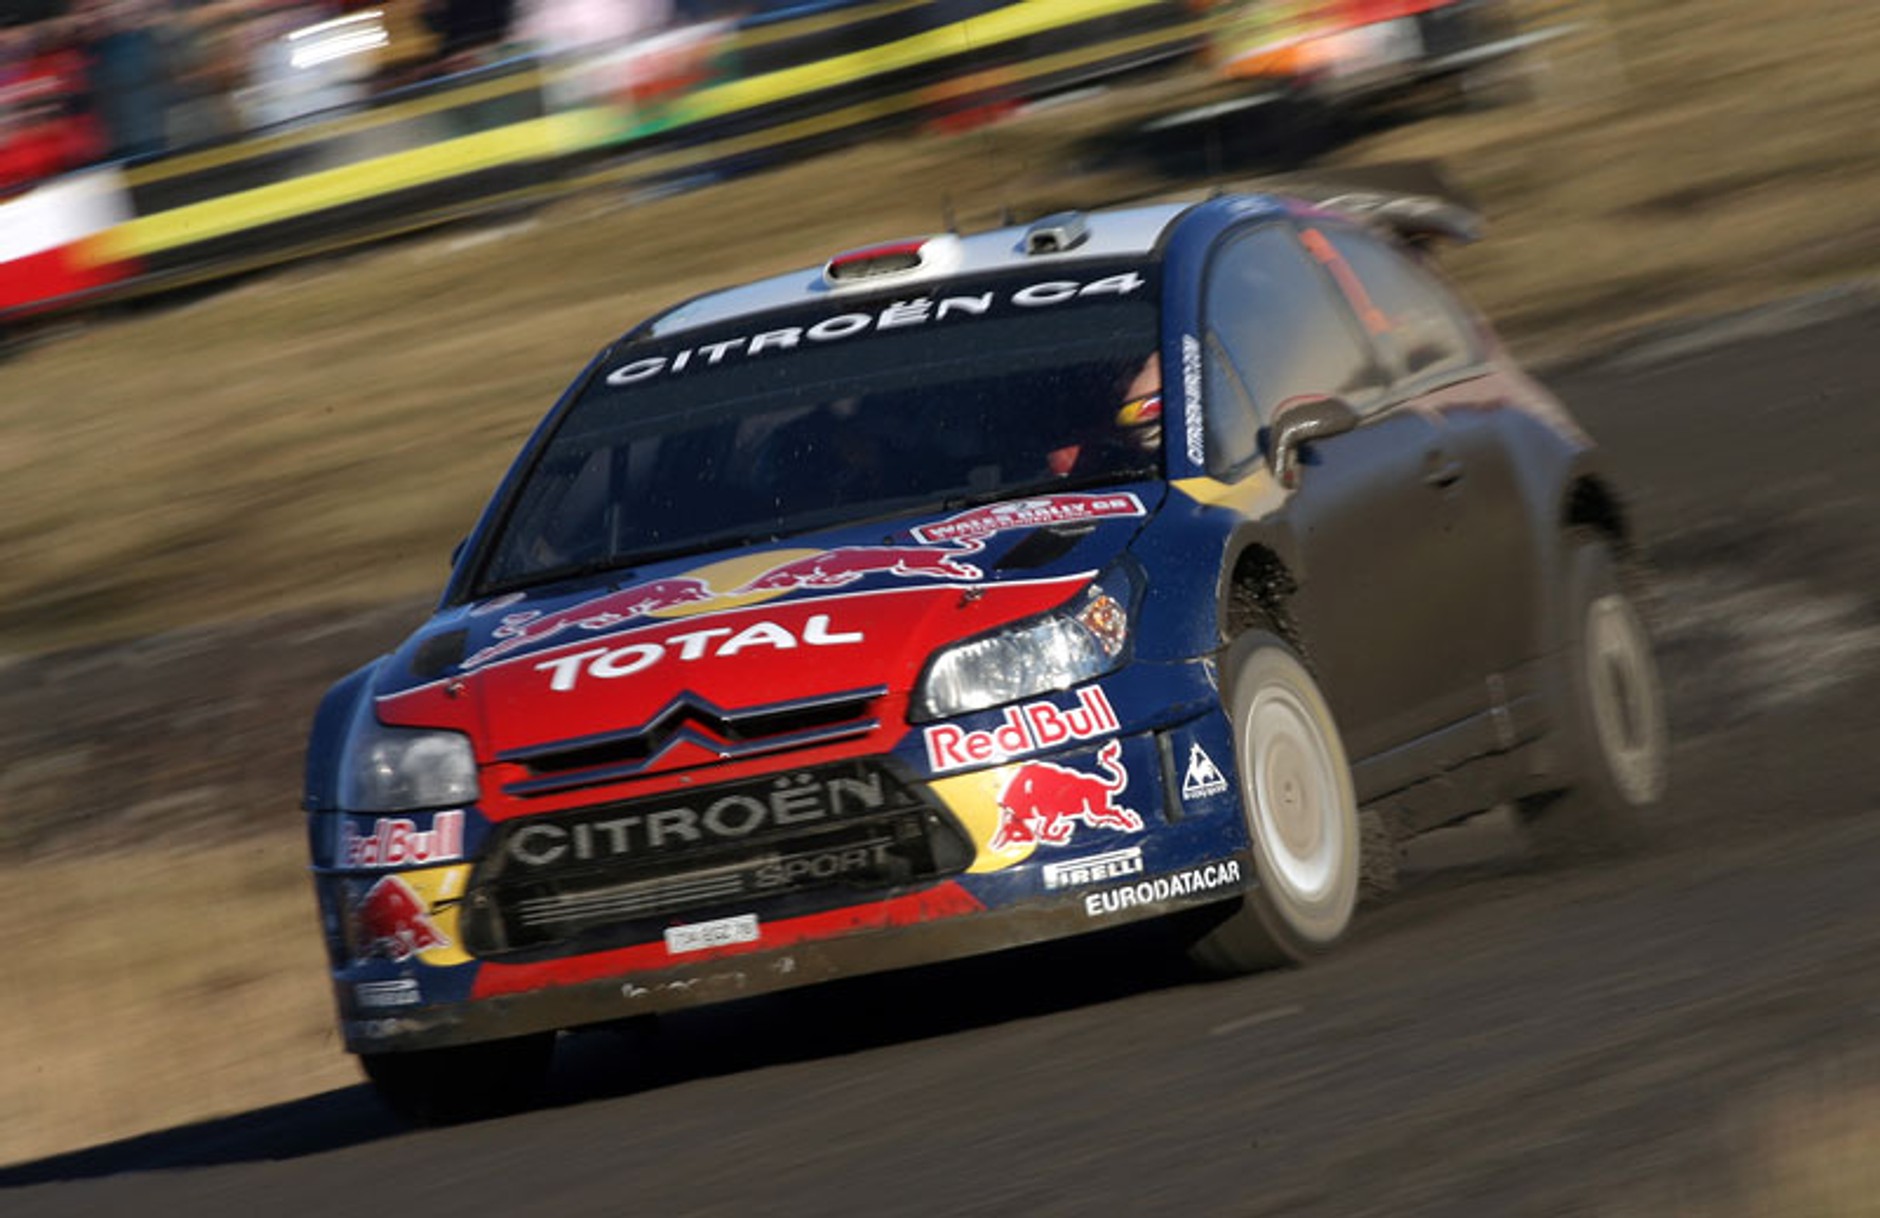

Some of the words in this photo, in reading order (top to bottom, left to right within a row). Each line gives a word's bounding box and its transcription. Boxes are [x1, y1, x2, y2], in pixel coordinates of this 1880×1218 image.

[606, 291, 995, 386] CITROËN
[1010, 271, 1148, 307] C4
[533, 614, 864, 692] TOTAL
[924, 706, 1037, 772] Red
[1026, 684, 1120, 749] Bull
[377, 808, 465, 868] Bull
[508, 771, 887, 866] CITROËN
[752, 838, 893, 889] SPORT
[1043, 847, 1144, 889] PIRELLI
[1085, 860, 1241, 917] EURODATACAR
